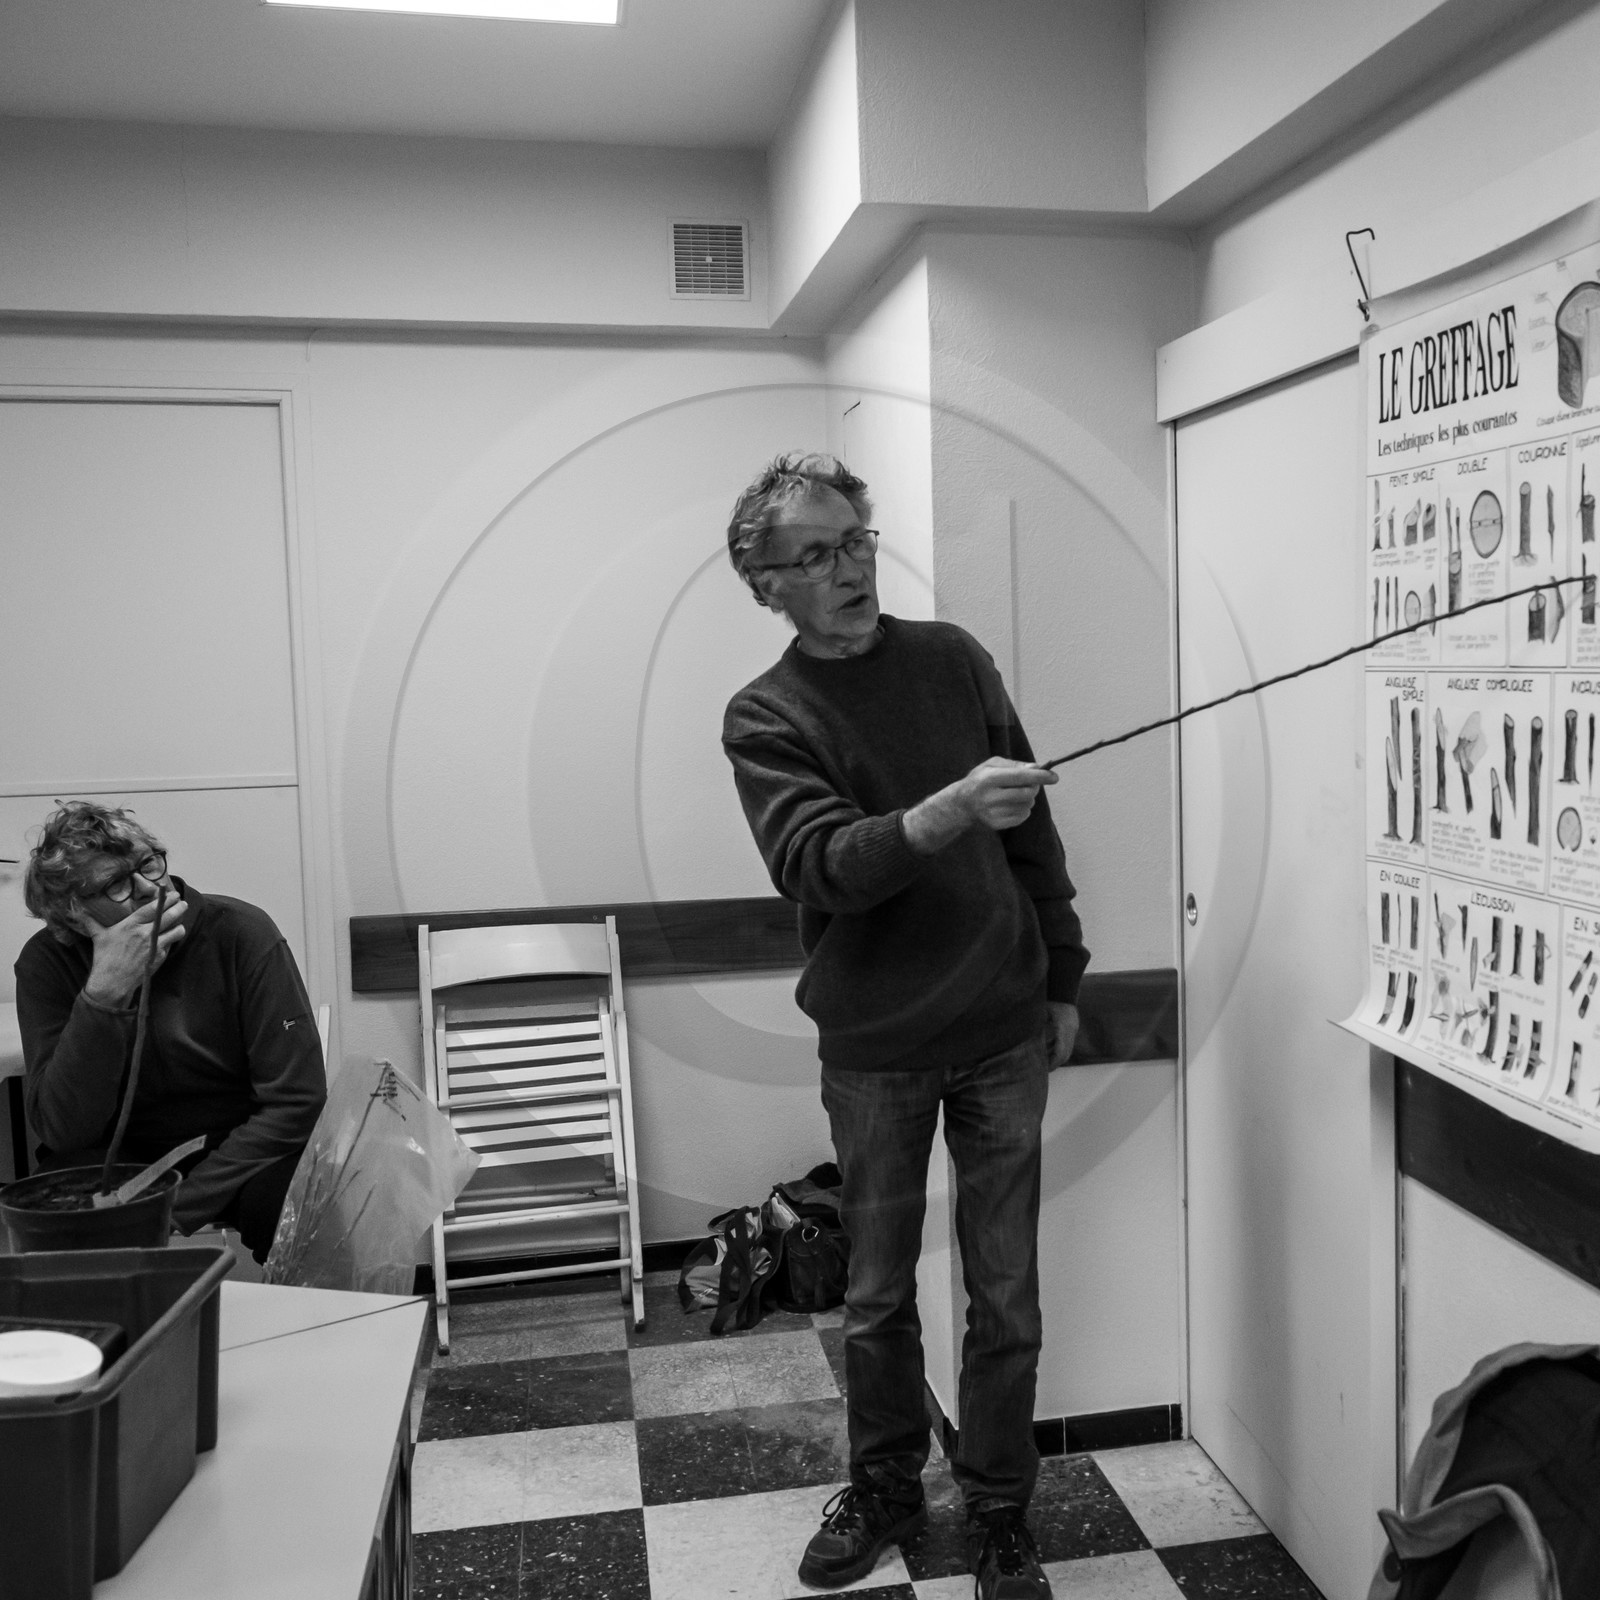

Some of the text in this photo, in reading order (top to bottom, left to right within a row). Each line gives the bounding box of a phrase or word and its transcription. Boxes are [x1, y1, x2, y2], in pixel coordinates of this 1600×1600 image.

[1378, 305, 1520, 424] LE GREFFAGE
[1378, 410, 1518, 457] Les techniques les plus courantes
[1518, 441, 1567, 463] COURONNE
[1457, 457, 1488, 475] DOUBLE
[1389, 468, 1436, 487] FENTE SIMPLE
[1385, 677, 1416, 689] ANGLAISE
[1447, 678, 1480, 691] ANGLAISE
[1402, 690, 1424, 701] SIMPLE
[1379, 870, 1391, 882] EN
[1573, 916, 1589, 933] EN
